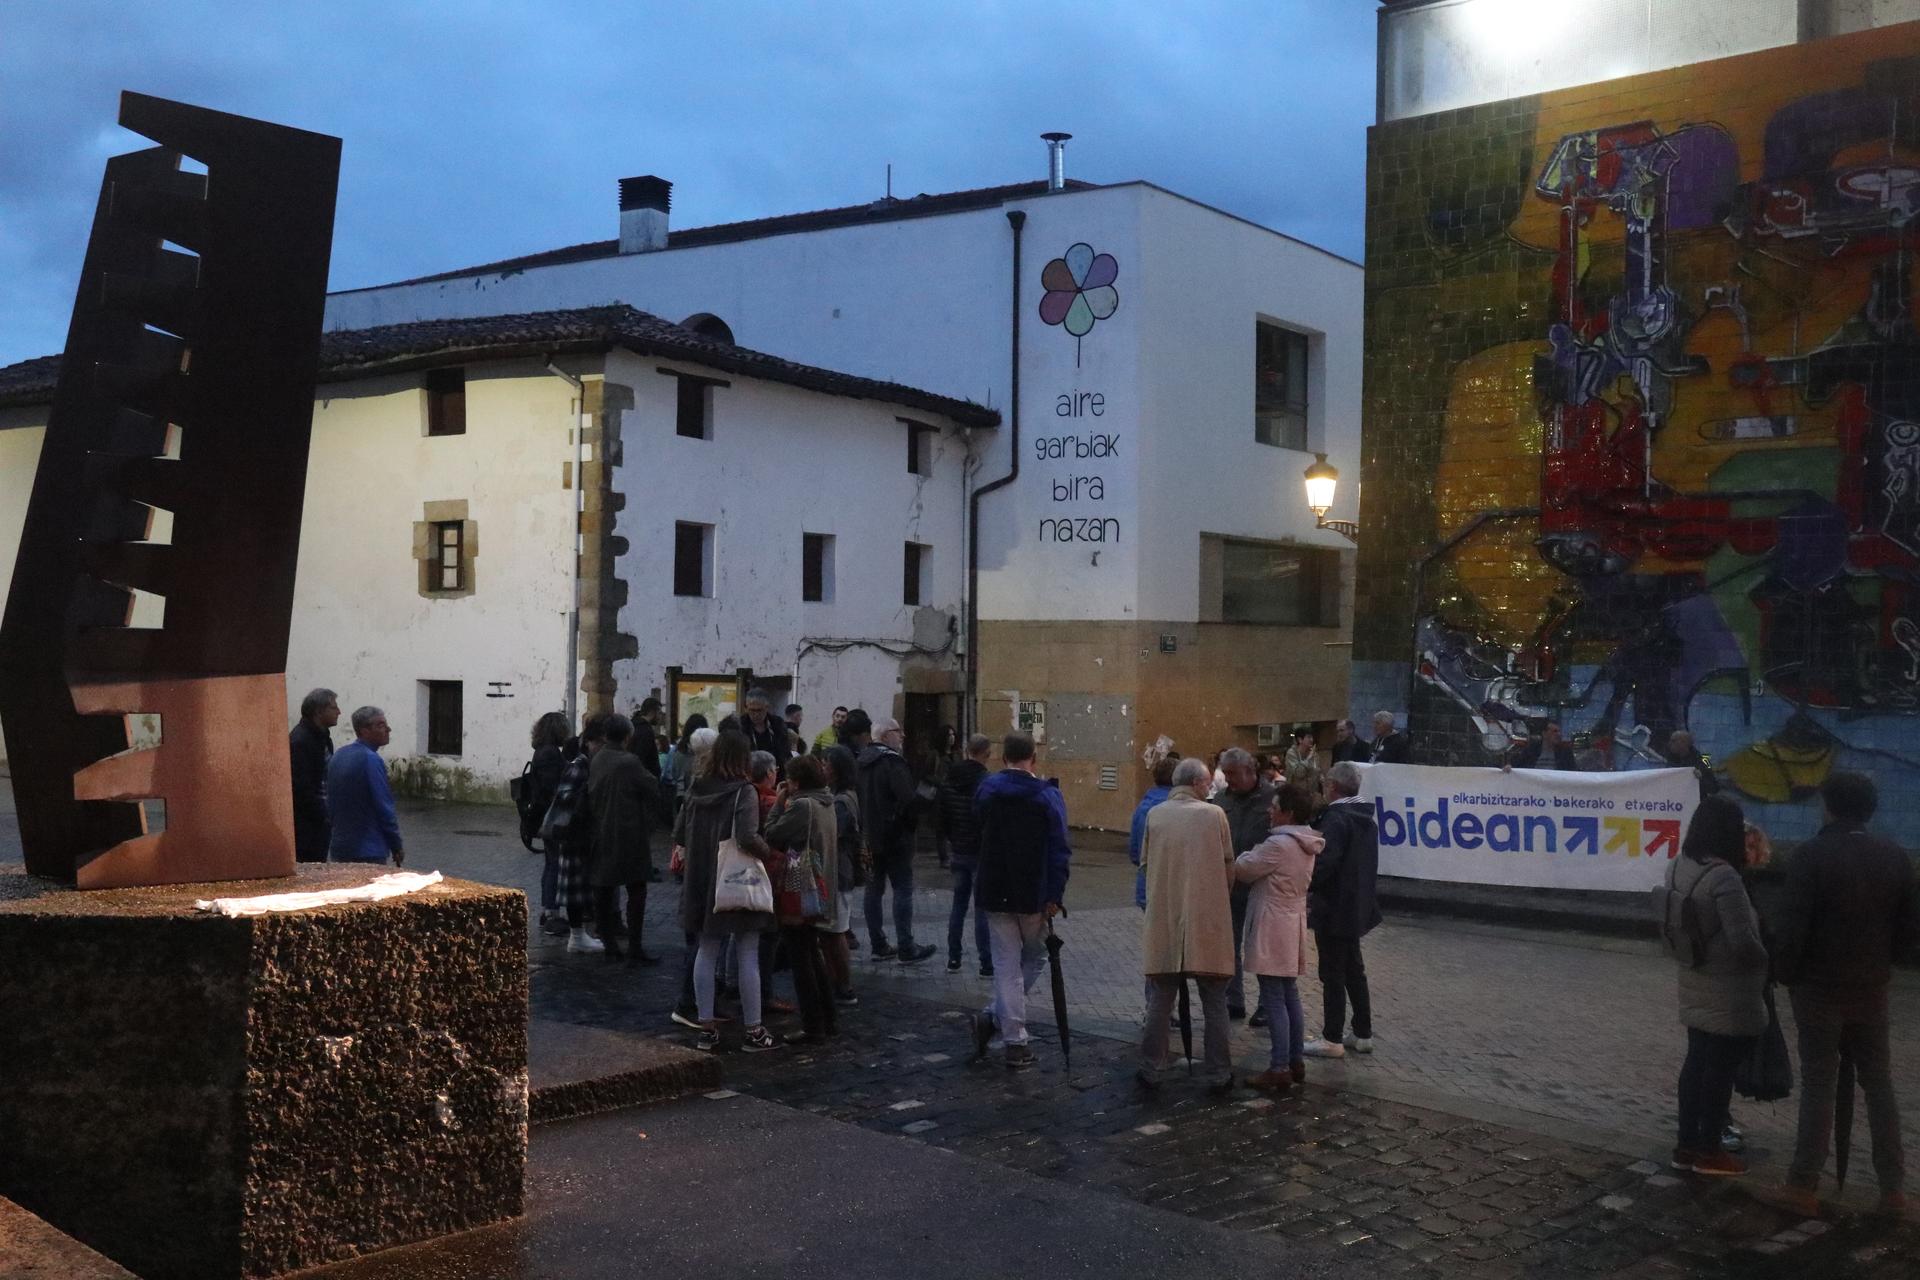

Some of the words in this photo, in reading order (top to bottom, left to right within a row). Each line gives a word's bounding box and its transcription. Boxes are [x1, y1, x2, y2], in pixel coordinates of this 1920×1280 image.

[1056, 389, 1105, 417] aire
[1035, 430, 1120, 460] garbiak
[1053, 474, 1103, 502] bira
[1040, 518, 1120, 542] nazan
[1453, 792, 1546, 807] elkarbizitzarako
[1553, 795, 1615, 810] bakerako
[1625, 799, 1684, 812] etxerako
[1375, 796, 1557, 852] bidean
